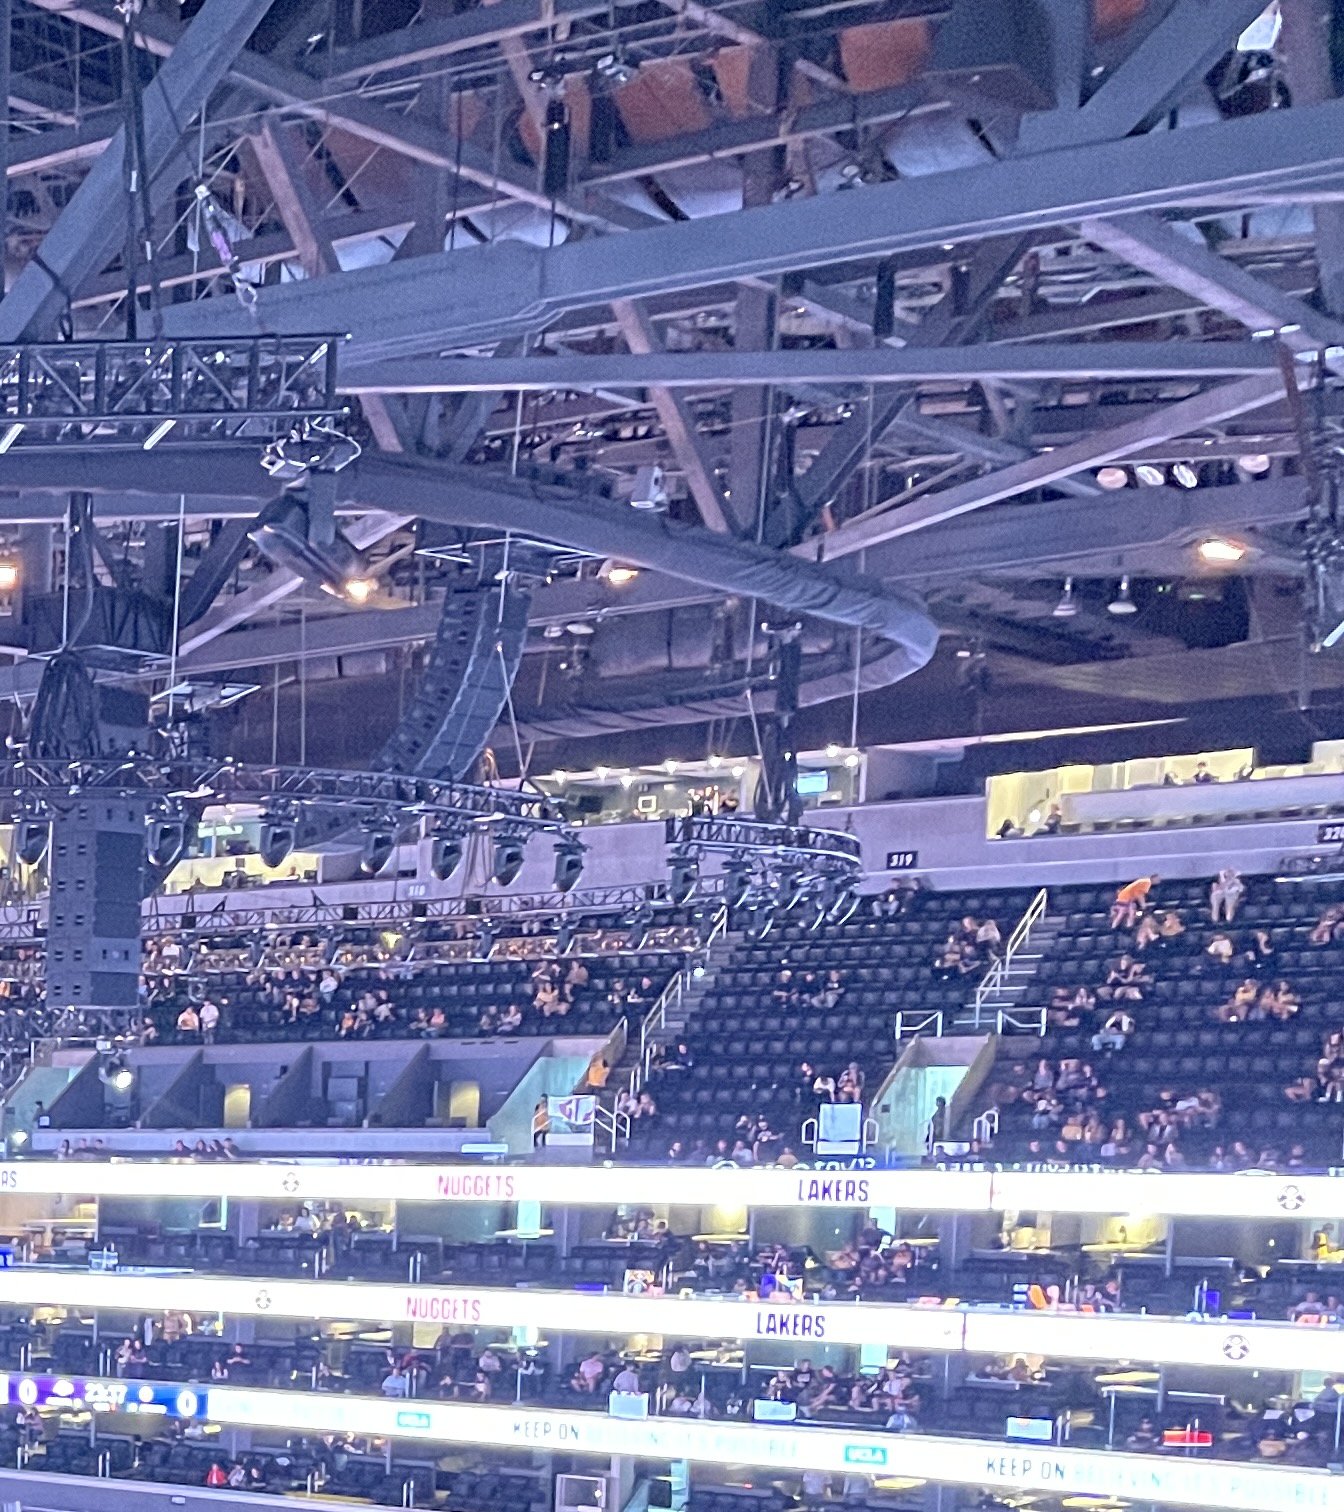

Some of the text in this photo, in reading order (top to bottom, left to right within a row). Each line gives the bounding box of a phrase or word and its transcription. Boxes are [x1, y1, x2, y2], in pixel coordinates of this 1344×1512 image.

[890, 853, 913, 867] 319
[437, 1174, 515, 1198] NUGGETS
[797, 1178, 870, 1202] LAKERS
[406, 1296, 482, 1321] NUGGETS
[756, 1312, 826, 1338] LAKERS
[18, 1378, 38, 1405] 0
[176, 1390, 198, 1417] 0
[512, 1420, 552, 1438] KEEP
[552, 1422, 580, 1441] ON
[847, 1447, 887, 1464] UCLA
[985, 1456, 1038, 1478] KEEP
[1041, 1460, 1066, 1481] ON
